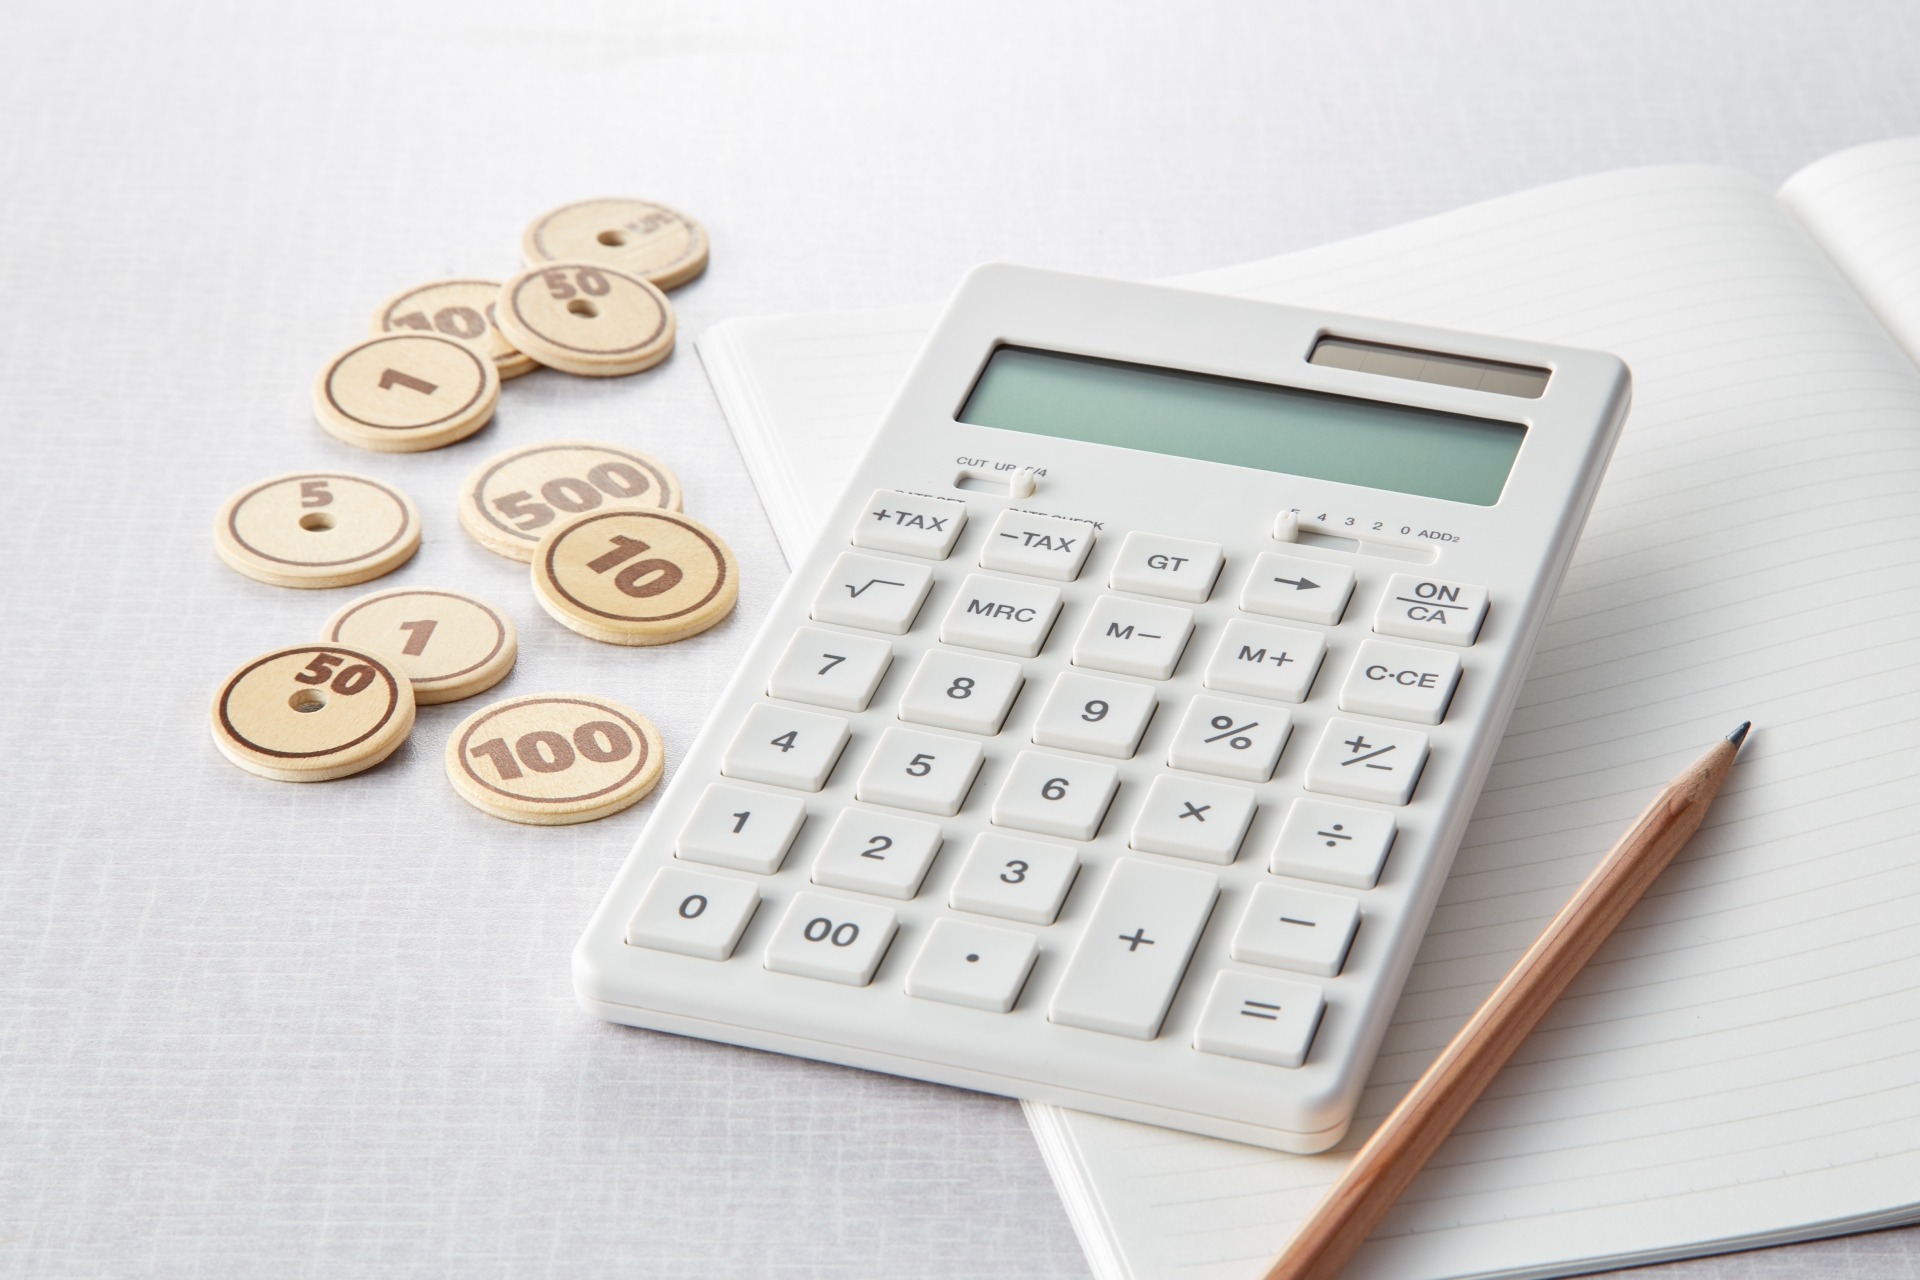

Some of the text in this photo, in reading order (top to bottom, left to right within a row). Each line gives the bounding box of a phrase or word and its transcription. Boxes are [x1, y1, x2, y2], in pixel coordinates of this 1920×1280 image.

[541, 267, 610, 300] 50
[392, 302, 496, 339] 10
[378, 368, 438, 395] 1
[956, 456, 989, 468] CUT
[994, 462, 1017, 472] UP
[300, 481, 333, 508] 5
[492, 461, 651, 531] 500
[872, 508, 949, 532] +TAX
[1317, 513, 1327, 522] 4
[1345, 517, 1356, 526] 3
[1372, 521, 1383, 531] 2
[1400, 526, 1411, 535] 0
[586, 534, 684, 598] 10
[1147, 554, 1189, 572] GT
[1414, 582, 1460, 603] ON
[967, 598, 1036, 622] MRC
[1406, 606, 1447, 625] CA
[399, 619, 438, 657] 1
[818, 654, 846, 676] 7
[1238, 645, 1294, 667] M+
[294, 653, 376, 696] 50
[947, 677, 975, 700] 8
[1081, 700, 1110, 723] 9
[470, 721, 633, 780] 100
[771, 731, 798, 753] 4
[905, 754, 935, 777] 5
[1042, 778, 1069, 801] 6
[732, 811, 751, 834] 1
[861, 836, 892, 861] 2
[1000, 860, 1029, 884] 3
[679, 895, 708, 920] 0
[804, 918, 860, 948] 00
